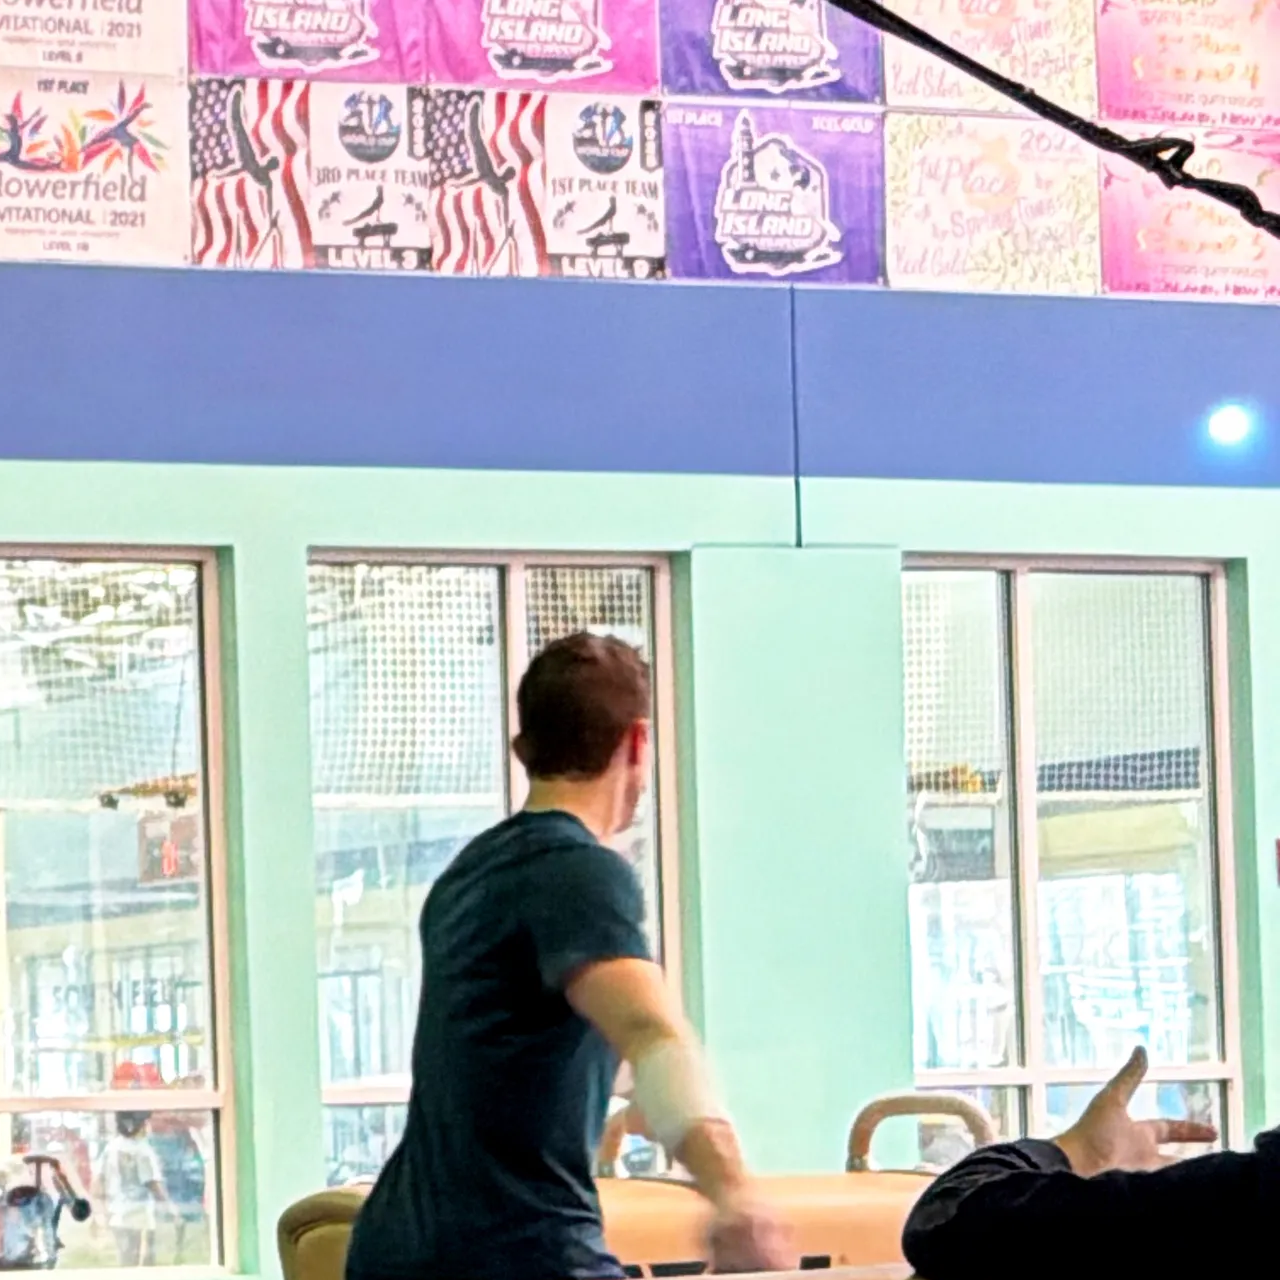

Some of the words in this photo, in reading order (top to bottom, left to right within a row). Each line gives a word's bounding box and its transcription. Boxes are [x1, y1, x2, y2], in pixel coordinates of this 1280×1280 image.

[253, 5, 350, 32] ISLAND
[719, 5, 790, 28] LONG
[107, 20, 142, 38] 2021
[490, 17, 583, 44] ISLAND
[720, 30, 812, 54] ISLAND
[57, 80, 89, 95] PLACE
[685, 111, 723, 128] PLACE
[314, 166, 341, 187] 3RD
[346, 167, 388, 182] PLACE
[394, 169, 430, 189] TEAM
[551, 177, 573, 198] 1ST
[578, 177, 620, 194] PLACE
[625, 179, 659, 200] TEAM
[720, 188, 791, 212] LONG
[109, 210, 146, 227] 2021
[722, 213, 813, 237] ISLAND
[327, 247, 399, 269] LEVEL
[561, 255, 629, 278] LEVEL
